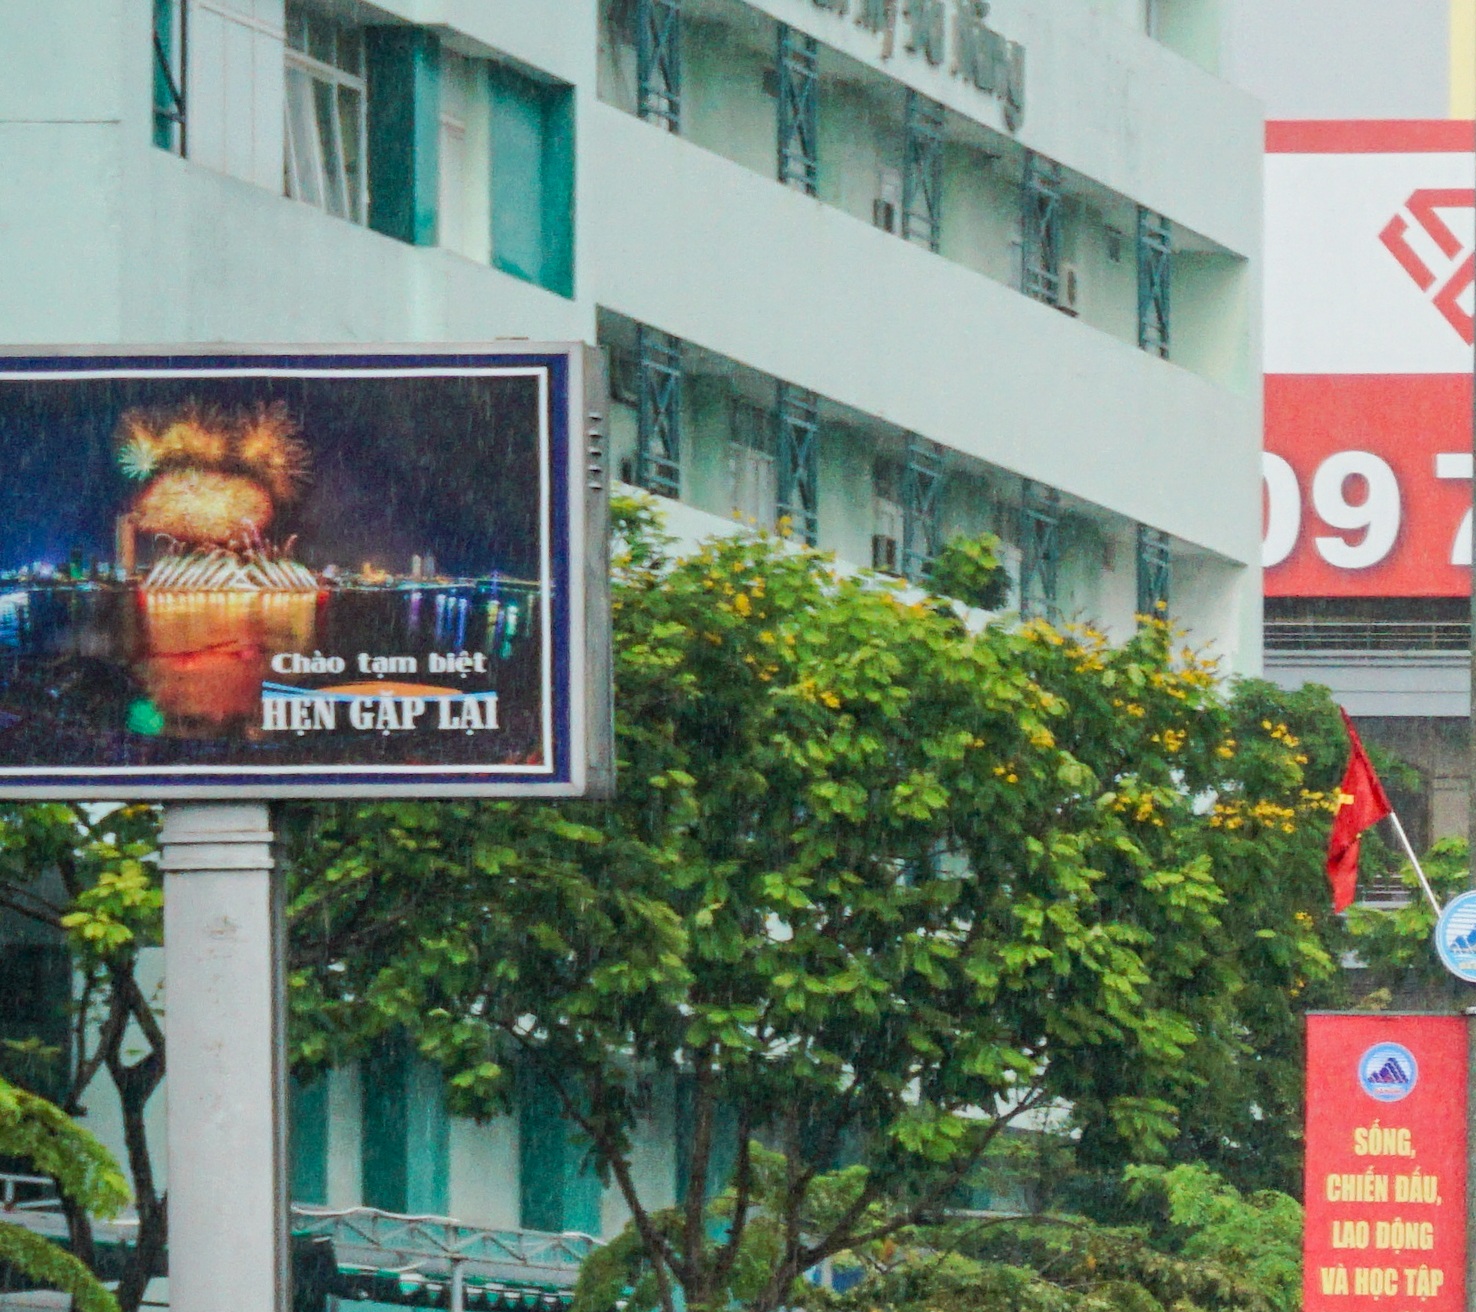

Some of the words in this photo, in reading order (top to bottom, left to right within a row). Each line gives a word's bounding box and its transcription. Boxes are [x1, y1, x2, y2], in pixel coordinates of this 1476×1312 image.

[270, 650, 346, 674] Chào
[357, 652, 418, 679] tạm
[428, 650, 488, 679] biệt
[261, 695, 336, 736] HẸN
[349, 689, 426, 736] GẶP
[438, 695, 500, 736] LẠI
[1353, 1118, 1416, 1160] SỐNG,
[1326, 1165, 1389, 1203] CHIẾN
[1395, 1166, 1442, 1206] ĐẤU,
[1332, 1221, 1370, 1249] LAO
[1376, 1217, 1434, 1254] ĐỘNG
[1320, 1263, 1349, 1296] VÀ
[1354, 1267, 1399, 1301] HỌC
[1404, 1264, 1444, 1302] TẬP
